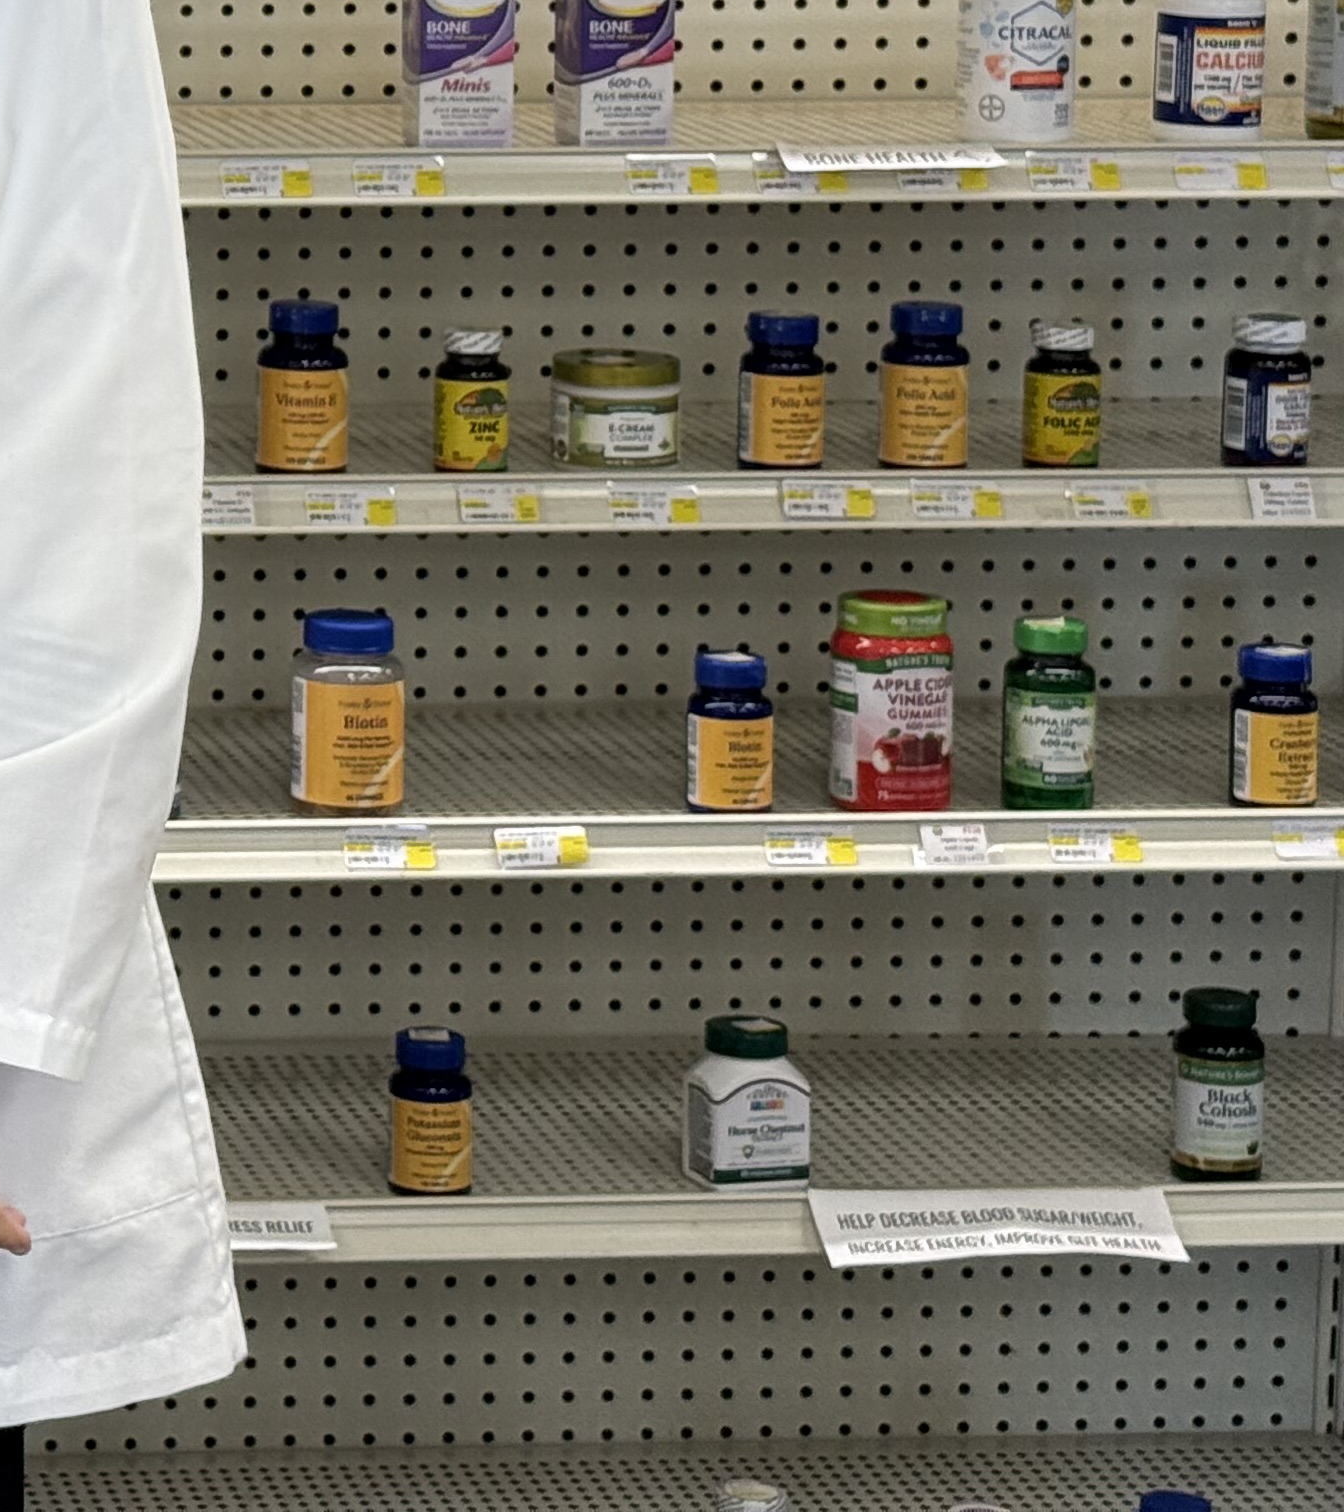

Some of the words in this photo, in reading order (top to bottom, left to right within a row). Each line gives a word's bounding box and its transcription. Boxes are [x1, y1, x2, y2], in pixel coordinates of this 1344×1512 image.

[426, 20, 471, 35] BONE
[589, 20, 634, 34] BONE
[441, 77, 491, 95] Minis
[275, 392, 324, 408] Vitamin
[896, 388, 926, 400] Folic
[929, 388, 956, 400] Acid
[468, 420, 500, 434] ZINC
[1043, 416, 1080, 429] FOLIC
[873, 678, 921, 692] APPLE
[343, 714, 388, 730] Biotin
[1021, 715, 1057, 725] ALPHA
[728, 740, 762, 752] Biotin
[1206, 1088, 1253, 1104] Black
[1198, 1102, 1257, 1119] Cohosh
[837, 1213, 875, 1230] HELP
[879, 1210, 960, 1229] DECREASE
[962, 1207, 1014, 1224] BLOOD
[264, 1220, 314, 1234] RELIEF
[848, 1240, 922, 1255] INCREASE
